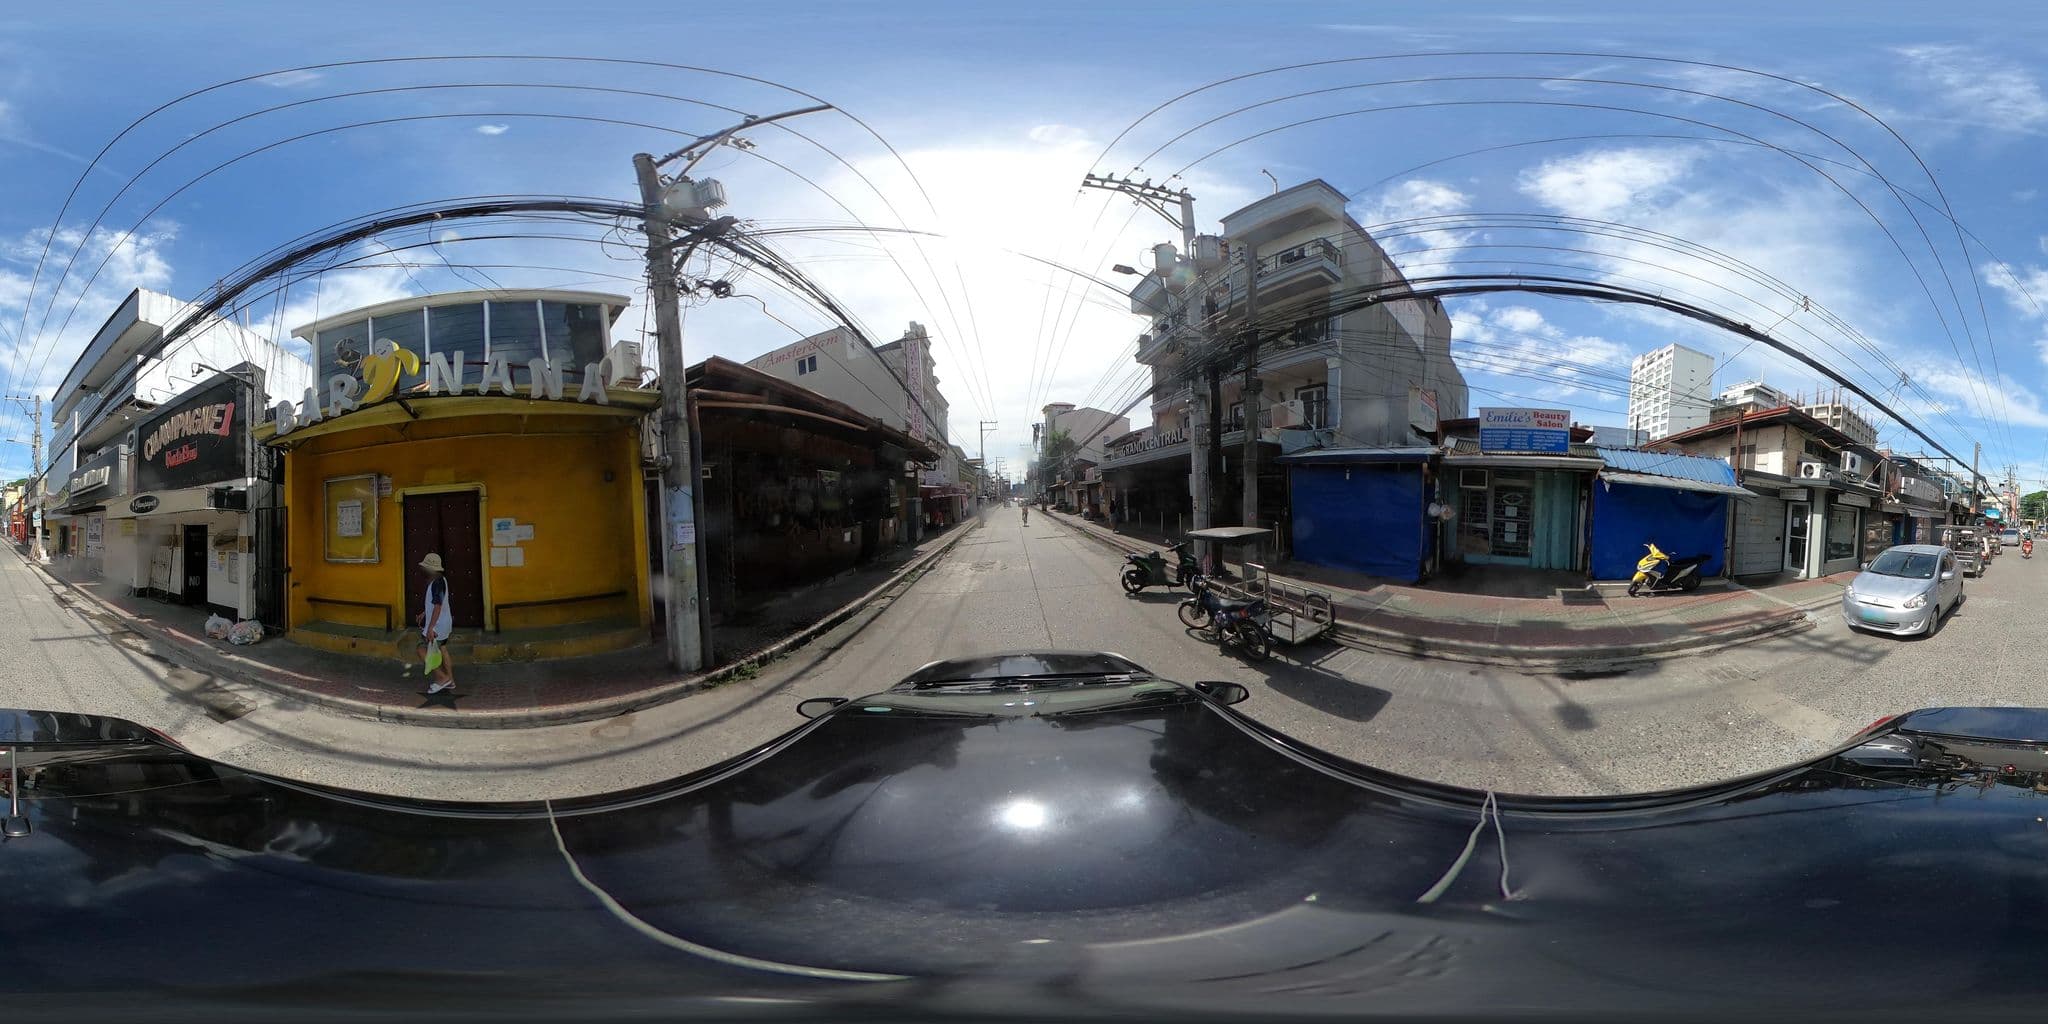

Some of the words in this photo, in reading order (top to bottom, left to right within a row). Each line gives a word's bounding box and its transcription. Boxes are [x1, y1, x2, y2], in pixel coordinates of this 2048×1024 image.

[276, 373, 361, 436] BAR
[429, 350, 609, 405] NANA
[1486, 410, 1531, 423] Emilie's
[1533, 411, 1568, 421] Beauty
[1536, 420, 1563, 429] Salon
[144, 404, 227, 461] CHAMPAGNE
[1121, 440, 1144, 457] GRAND
[1144, 427, 1184, 450] CENTRAL
